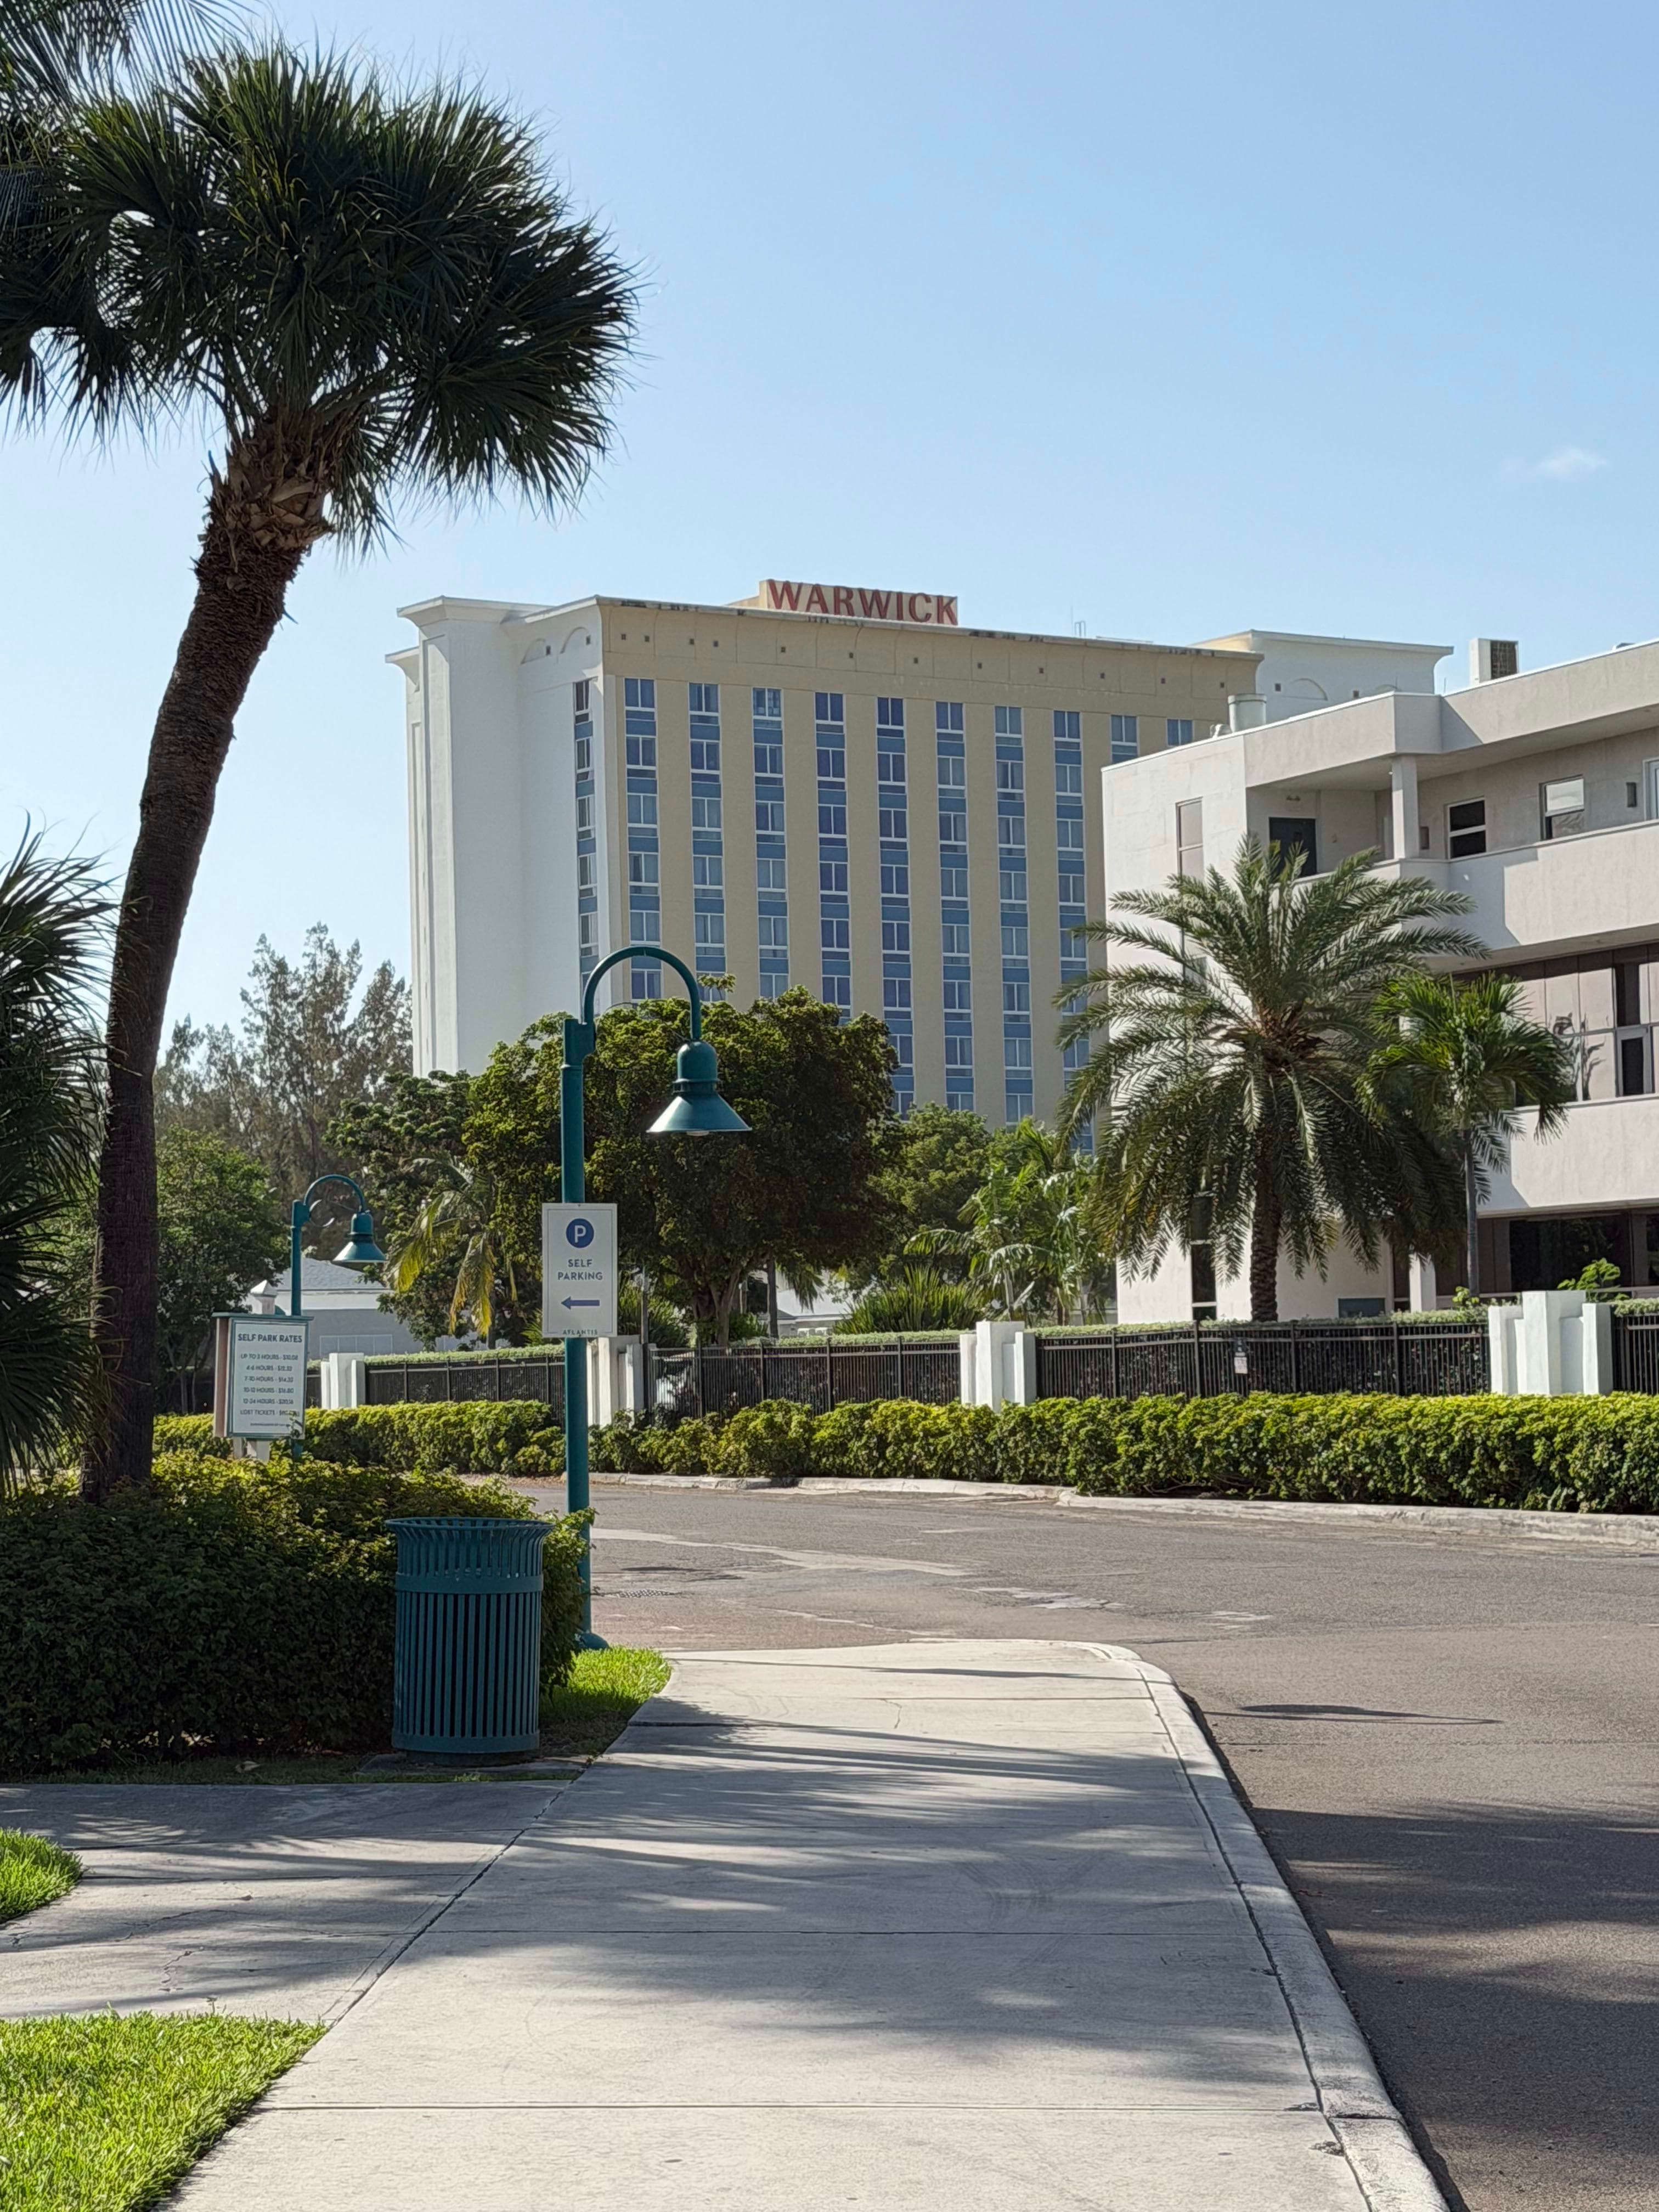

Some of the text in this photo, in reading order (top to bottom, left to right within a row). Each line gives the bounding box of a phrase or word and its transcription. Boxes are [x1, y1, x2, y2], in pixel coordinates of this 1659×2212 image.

[768, 578, 958, 625] WARWICK
[574, 1225, 586, 1243] P
[568, 1259, 592, 1267] SELF
[557, 1272, 603, 1280] PARKING
[238, 1333, 256, 1341] SELF
[279, 1335, 302, 1343] RATES
